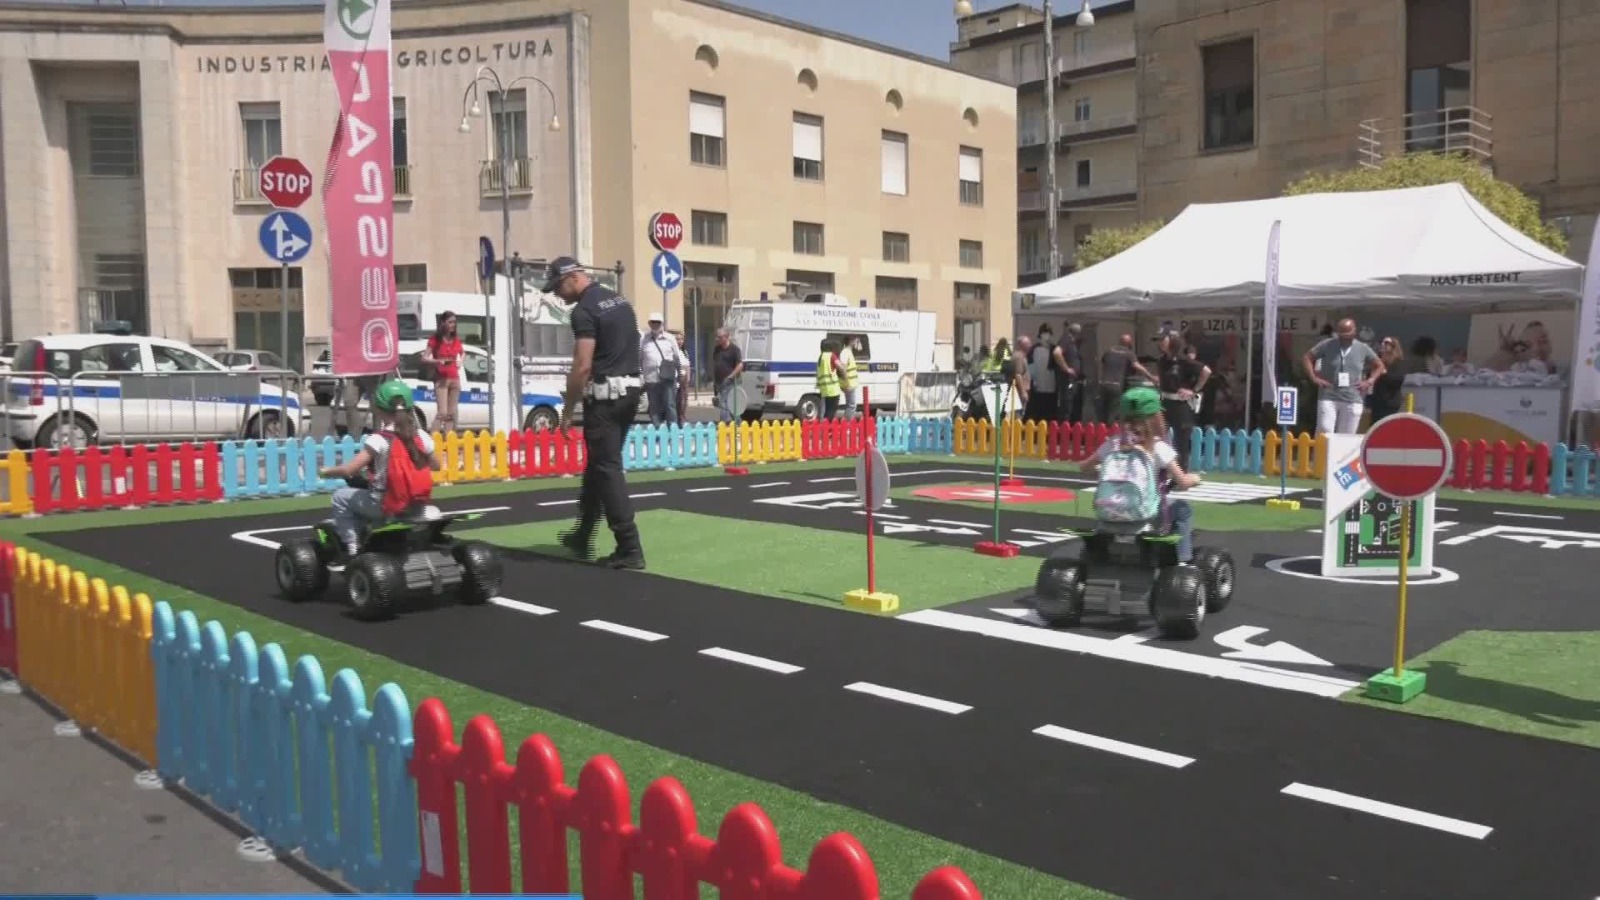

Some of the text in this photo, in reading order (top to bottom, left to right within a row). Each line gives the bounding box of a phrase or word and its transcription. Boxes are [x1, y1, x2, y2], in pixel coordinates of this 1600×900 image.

[198, 38, 553, 73] INDUSTRIA GRICOLTURA
[262, 171, 310, 194] STOP
[656, 223, 682, 240] STOP
[1430, 271, 1521, 287] MASTERTENT
[812, 309, 857, 319] PROTEZIONE
[1180, 318, 1300, 331] PIZIA LOLE
